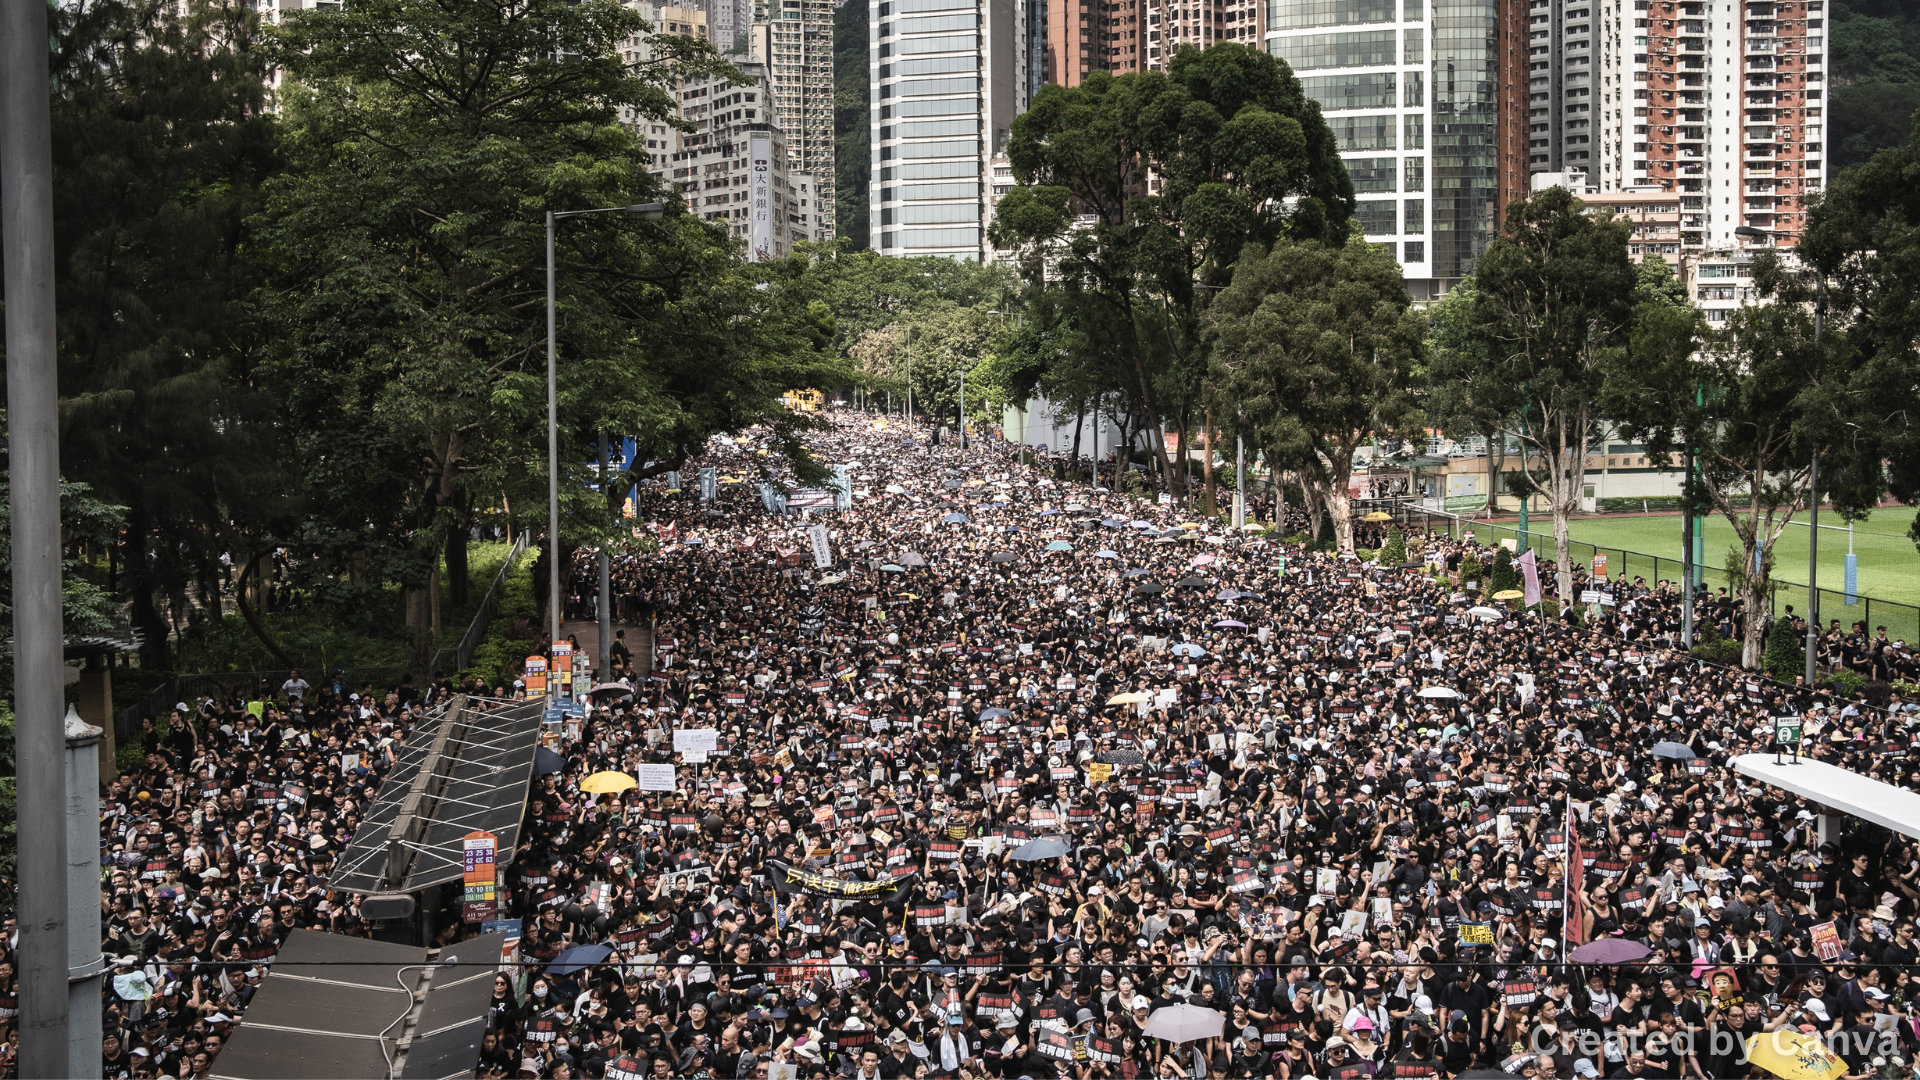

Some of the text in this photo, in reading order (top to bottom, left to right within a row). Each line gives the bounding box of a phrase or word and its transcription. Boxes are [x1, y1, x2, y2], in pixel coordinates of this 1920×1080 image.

[755, 174, 767, 220] 大新銀行
[786, 868, 840, 894] 反送中
